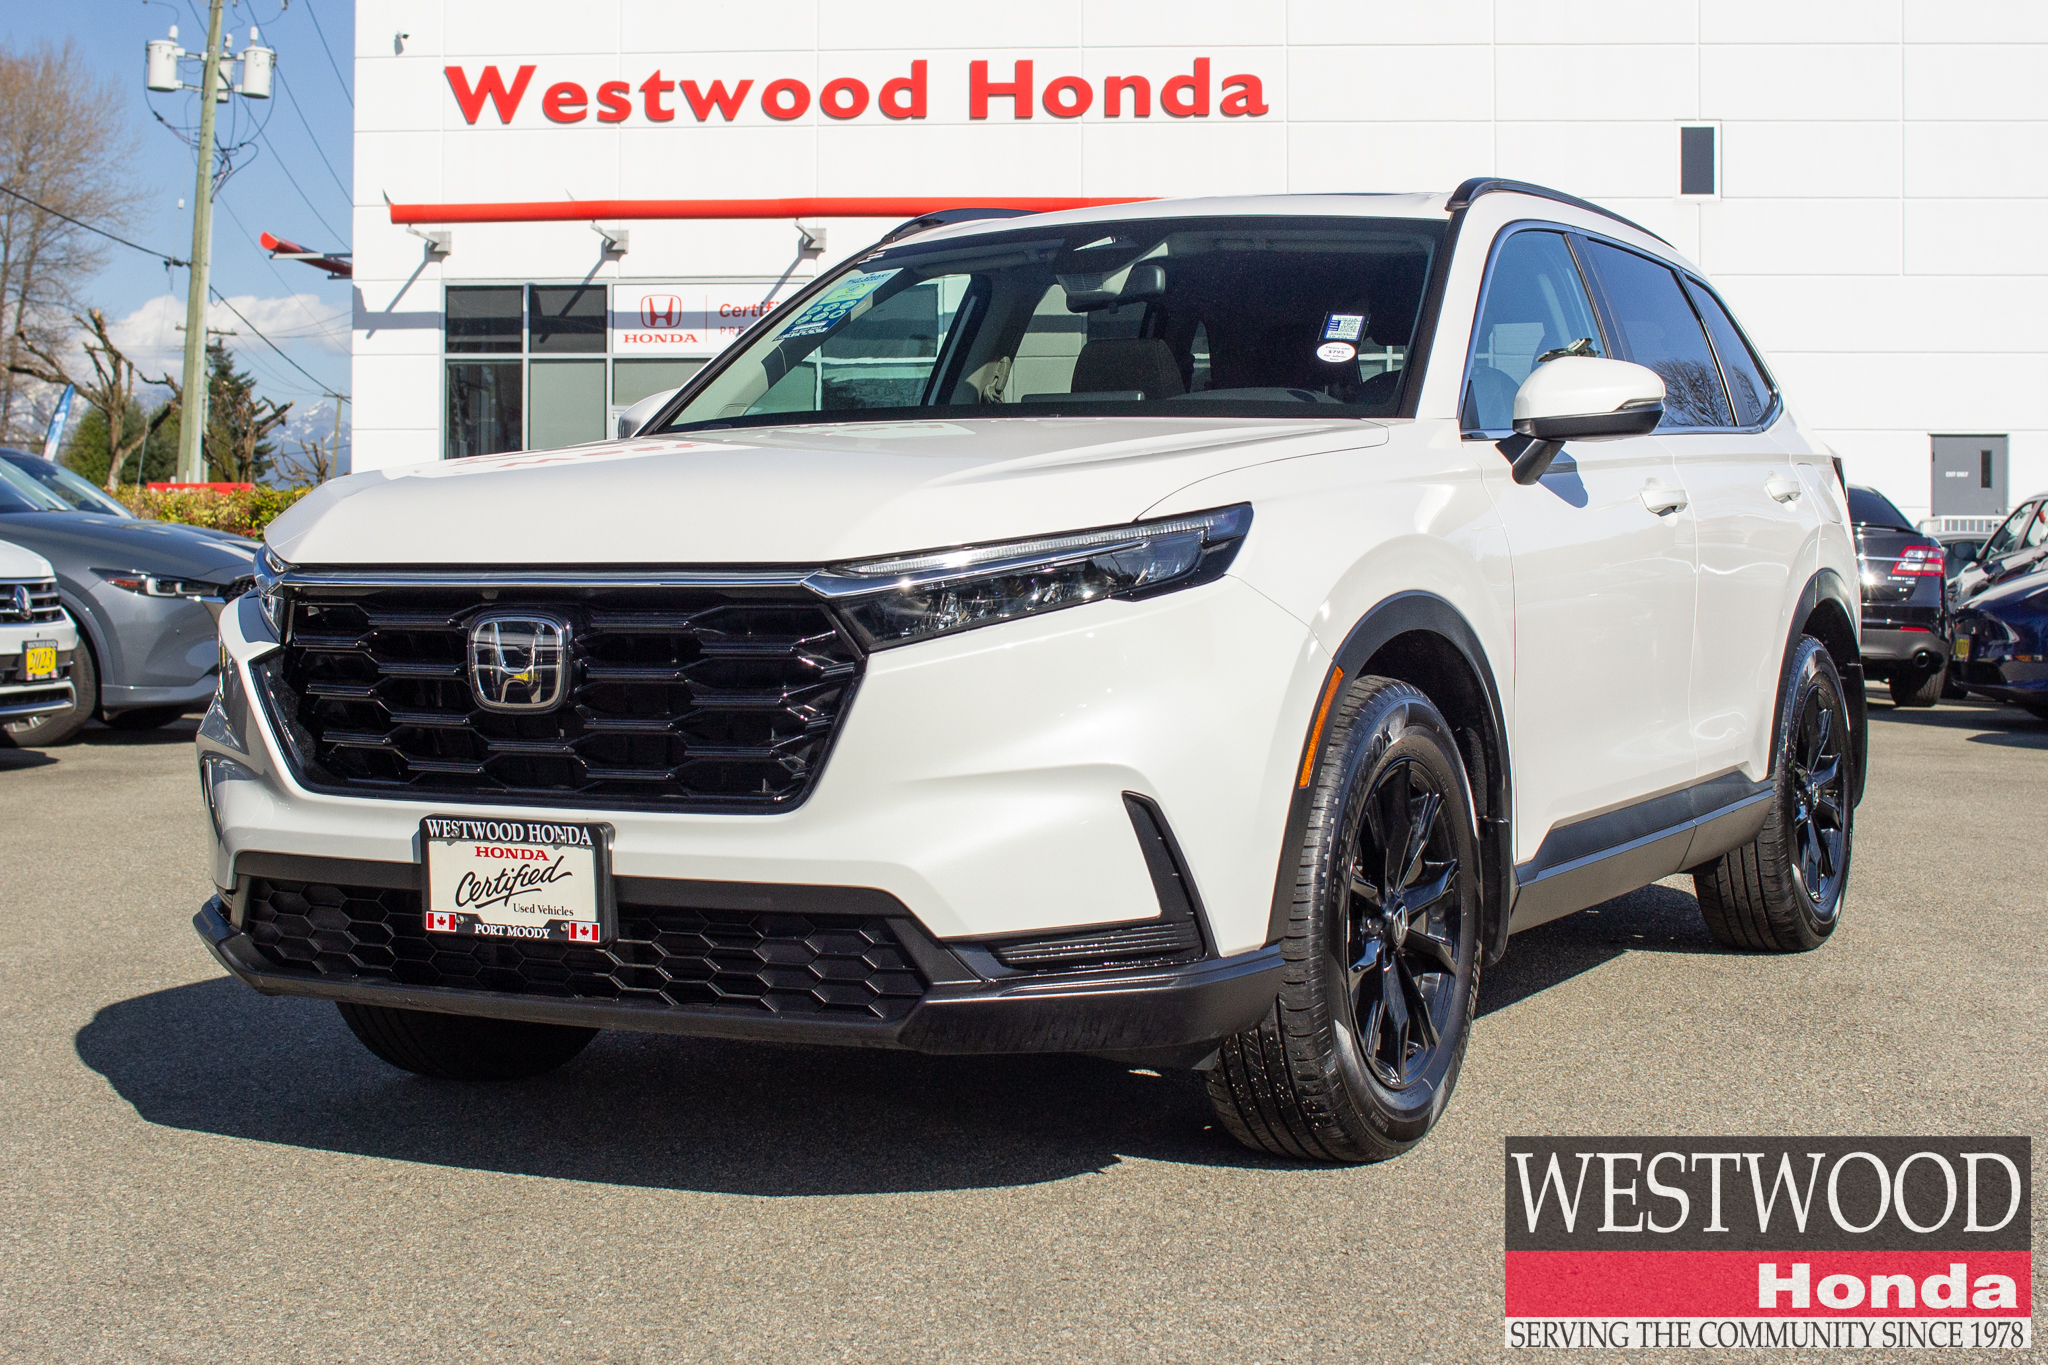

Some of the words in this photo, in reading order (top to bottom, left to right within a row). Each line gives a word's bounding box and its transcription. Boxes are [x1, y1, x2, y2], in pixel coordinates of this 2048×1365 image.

[444, 59, 928, 125] Westwood
[969, 57, 1269, 119] Honda
[623, 333, 699, 344] HONDA
[28, 650, 54, 671] 2023
[425, 818, 525, 842] WESTWOOD
[528, 824, 593, 846] HONDA
[474, 845, 550, 862] HONDA
[455, 855, 573, 907] Certified
[513, 902, 536, 914] Used
[537, 903, 574, 917] Vehicles
[474, 923, 505, 936] PORT
[507, 925, 551, 939] MOODY
